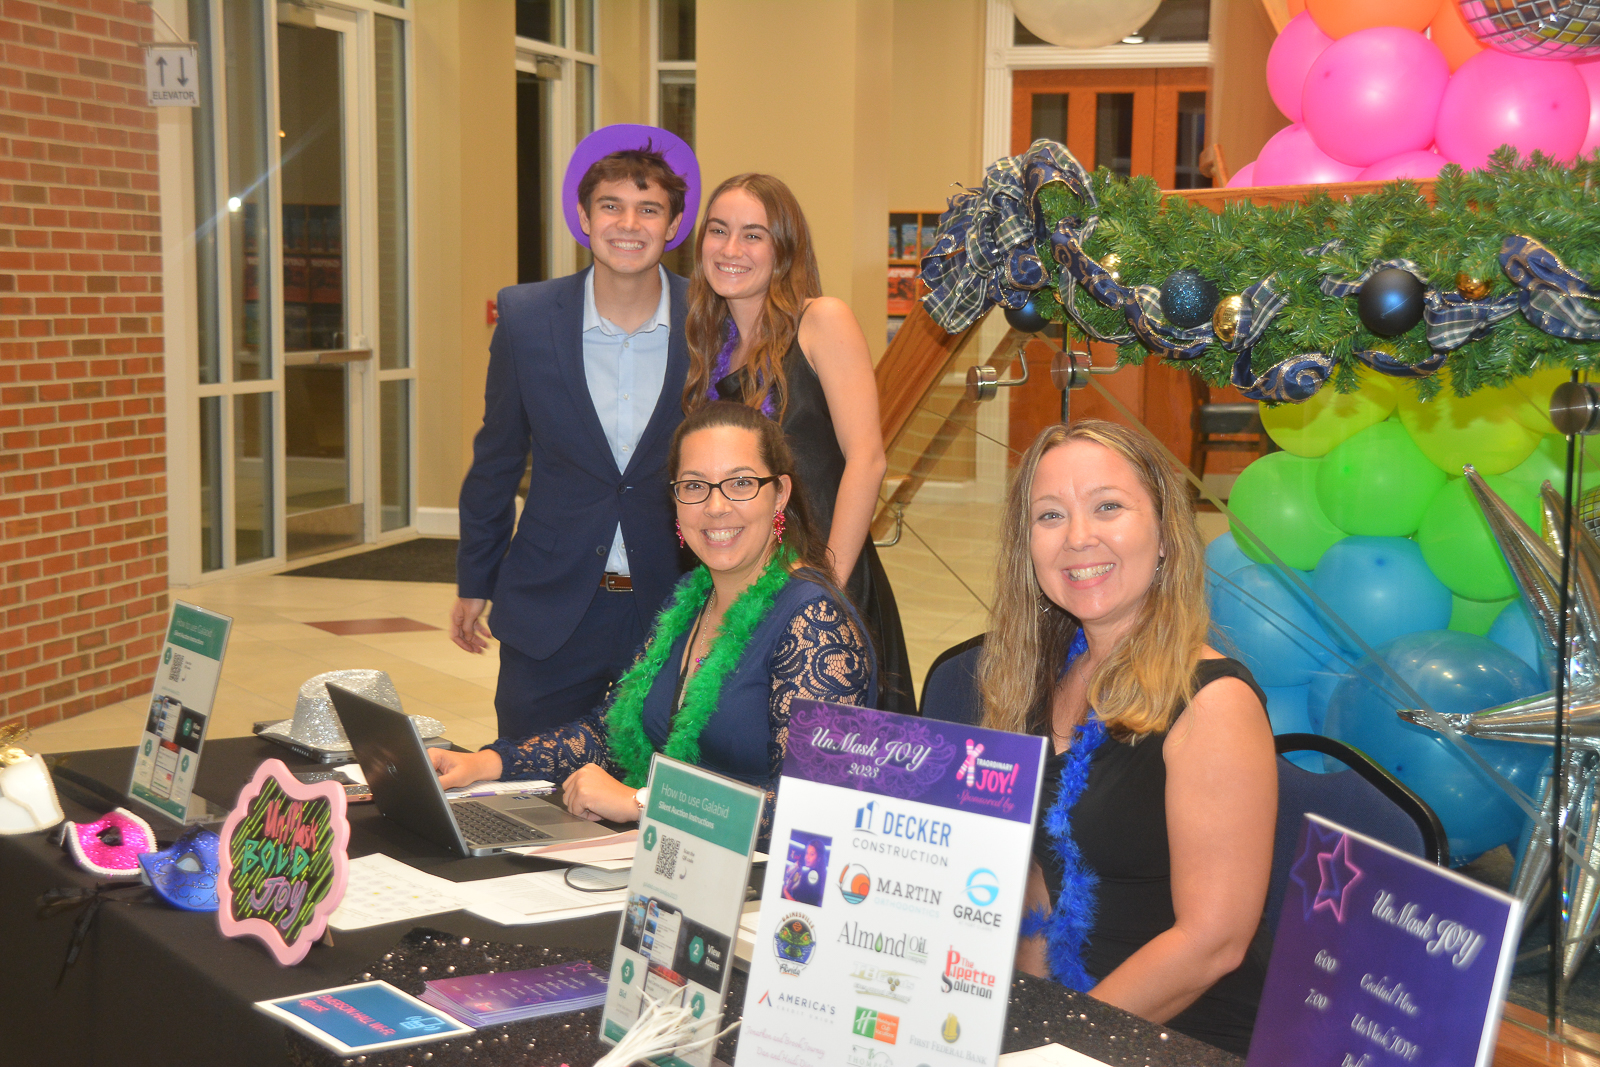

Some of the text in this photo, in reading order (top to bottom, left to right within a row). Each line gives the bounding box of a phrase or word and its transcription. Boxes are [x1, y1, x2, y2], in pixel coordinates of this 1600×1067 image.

[152, 91, 194, 100] ELEVATOR
[811, 726, 932, 772] UnMask JOY
[847, 762, 880, 778] 2023
[975, 763, 1020, 794] JOY!
[661, 782, 731, 819] How to use Galabid
[658, 800, 715, 830] Silent Auction Instructions
[646, 832, 652, 844] 1
[882, 811, 952, 848] DECKER
[241, 839, 310, 877] BOLD
[852, 837, 949, 867] CONSTRUCTION
[876, 877, 943, 906] MARTIN
[873, 896, 940, 919] ORTHODONTICS
[953, 904, 1002, 928] GRACE
[837, 920, 907, 959] Almond
[1371, 889, 1486, 968] UnMask JOY
[692, 943, 699, 956] 2
[707, 944, 721, 958] View
[1313, 949, 1337, 972] 6:00
[624, 965, 630, 977] 3
[705, 956, 720, 971] items
[945, 944, 996, 988] Pipette
[961, 957, 975, 969] The
[941, 970, 993, 1000] Solution
[1360, 973, 1417, 1014] Cocktail Hour
[693, 1000, 700, 1011] 4
[778, 992, 836, 1016] AMERICA'S
[1304, 988, 1328, 1009] 7:00
[909, 1034, 988, 1066] FIRST FEDERAL BANK
